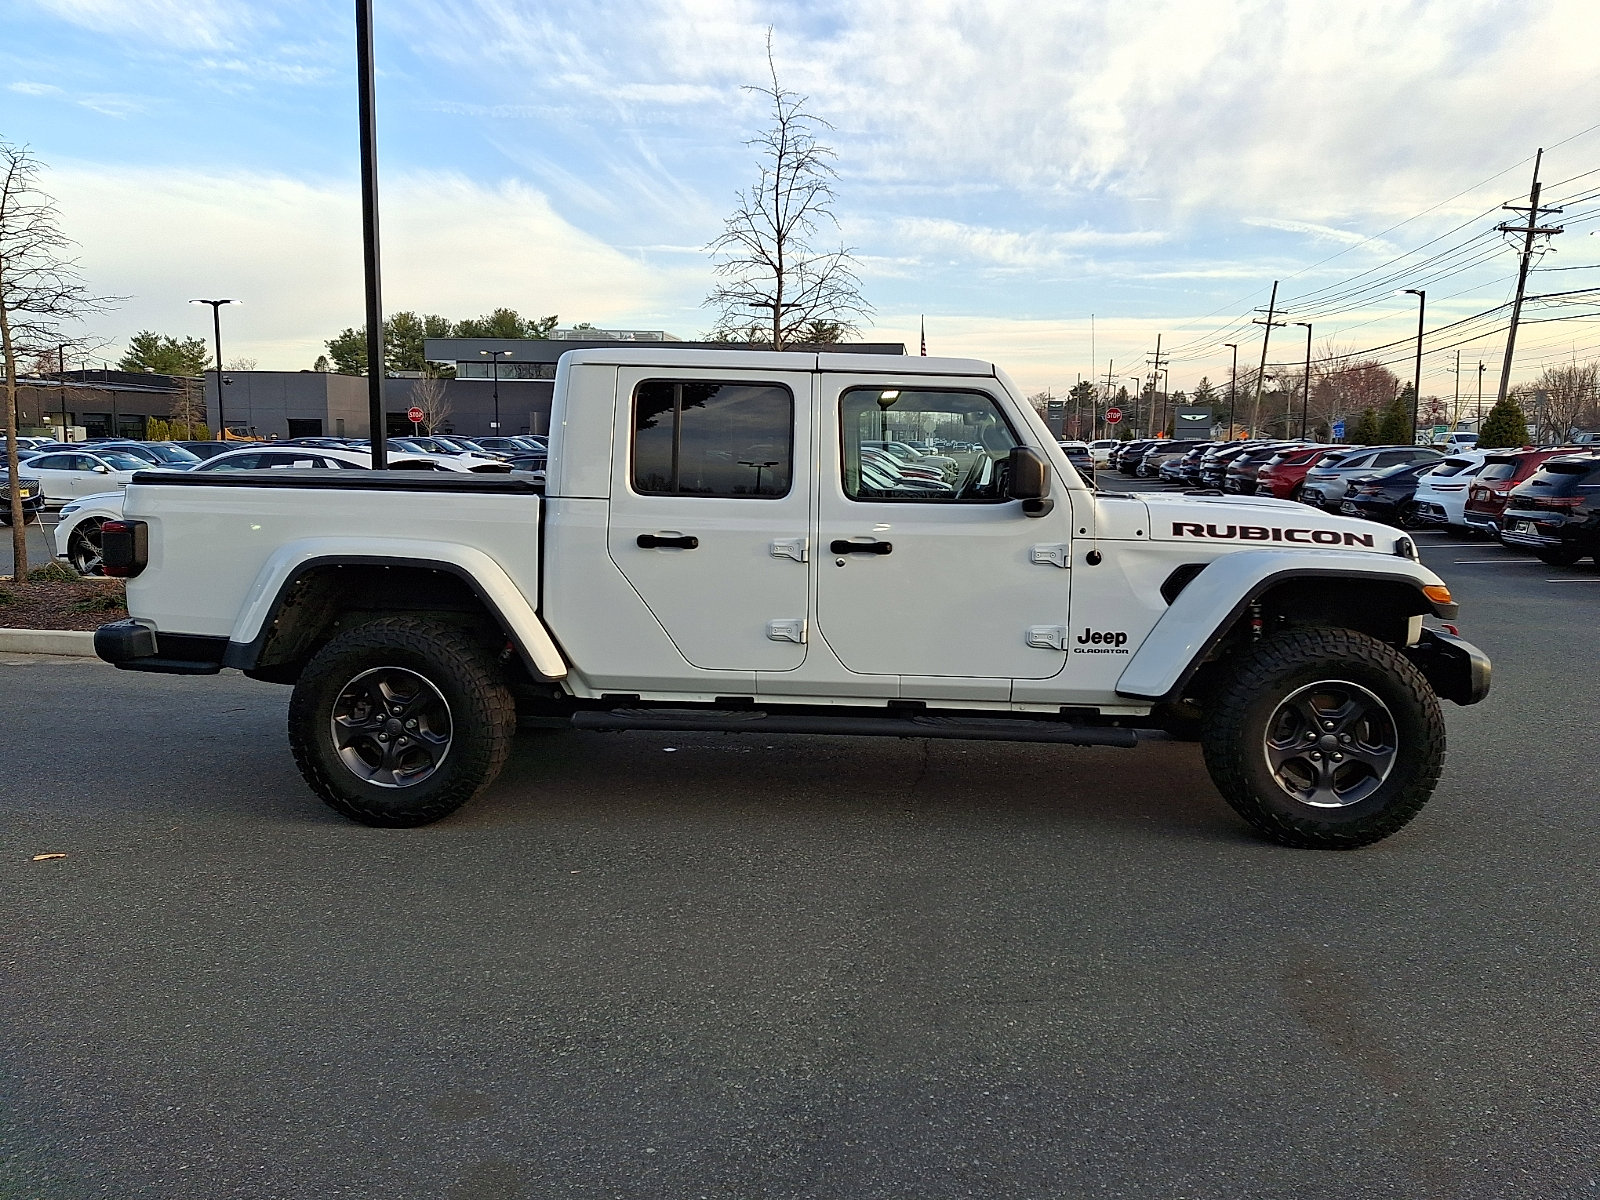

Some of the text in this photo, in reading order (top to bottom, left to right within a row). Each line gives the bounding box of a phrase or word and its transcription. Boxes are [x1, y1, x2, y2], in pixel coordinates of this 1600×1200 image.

[1106, 411, 1121, 419] STOP
[1172, 521, 1375, 548] RUBICON
[1077, 627, 1128, 648] Jeep
[1073, 647, 1129, 655] GLADIATOR
